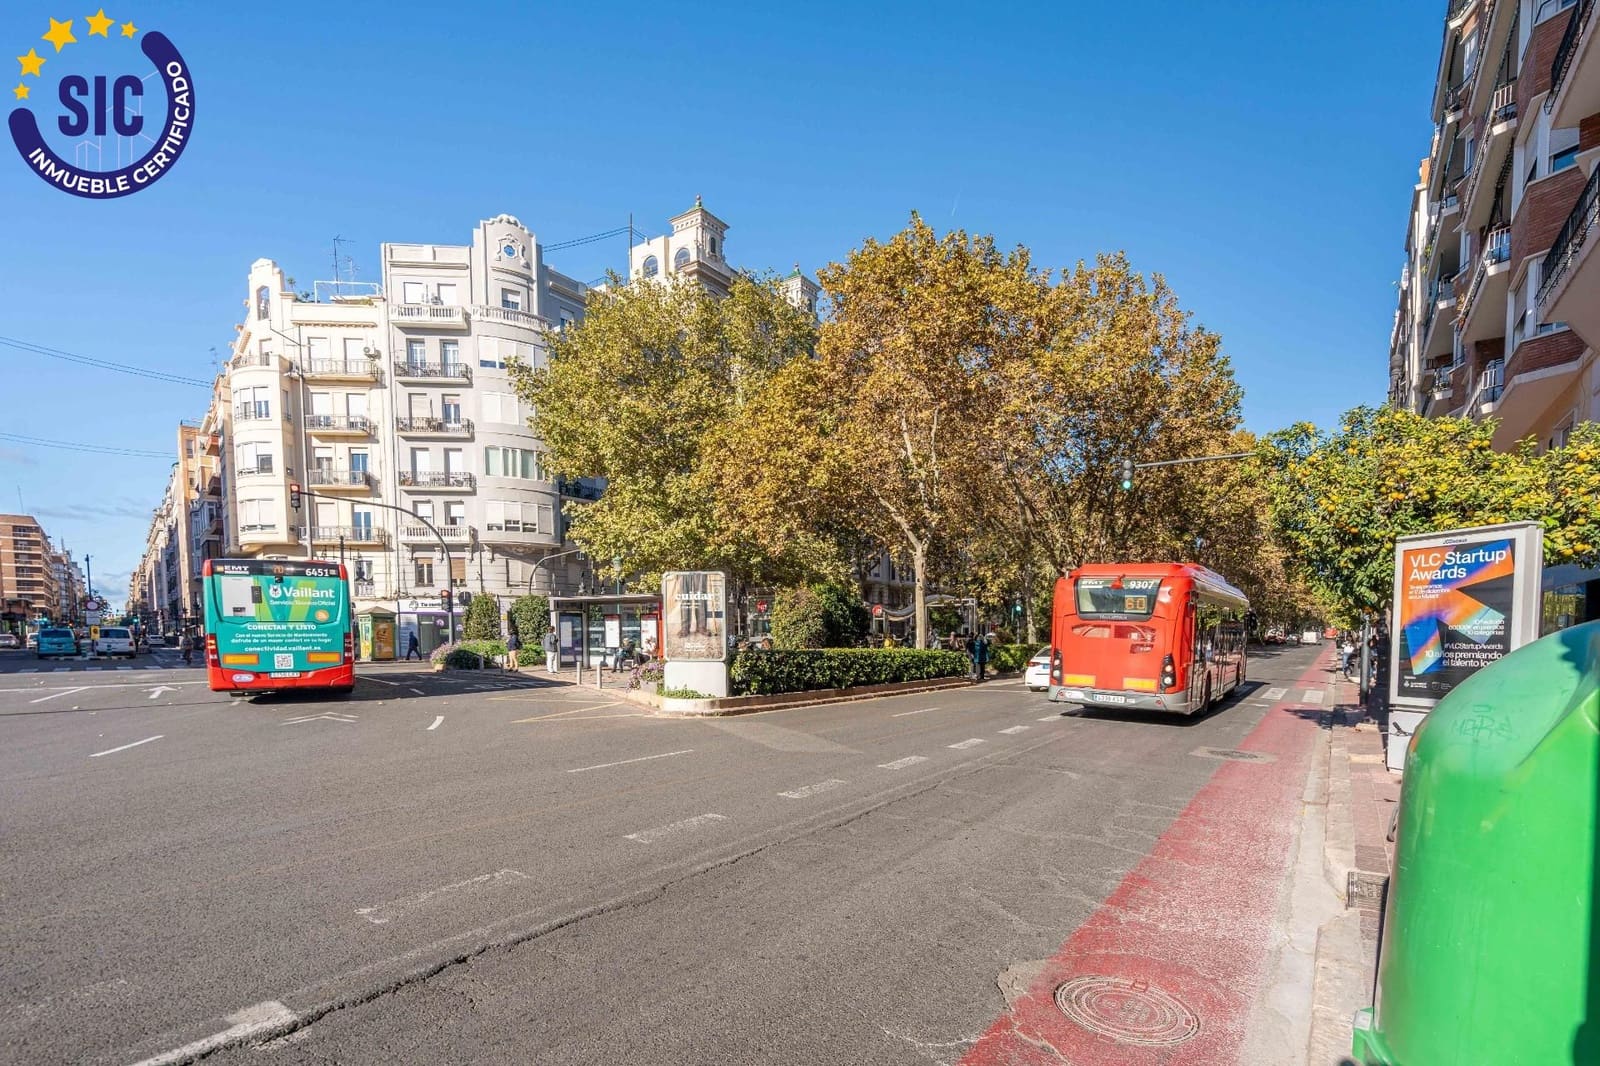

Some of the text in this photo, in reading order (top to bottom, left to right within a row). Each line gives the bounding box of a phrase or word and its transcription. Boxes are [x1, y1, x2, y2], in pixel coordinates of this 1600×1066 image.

[1410, 549, 1507, 568] VLC Startup
[305, 568, 330, 577] 6451
[1409, 565, 1468, 582] Awards
[1129, 580, 1155, 590] 9307
[282, 586, 336, 598] Vaillant
[1455, 651, 1503, 660] premiando
[1450, 659, 1479, 667] talento
